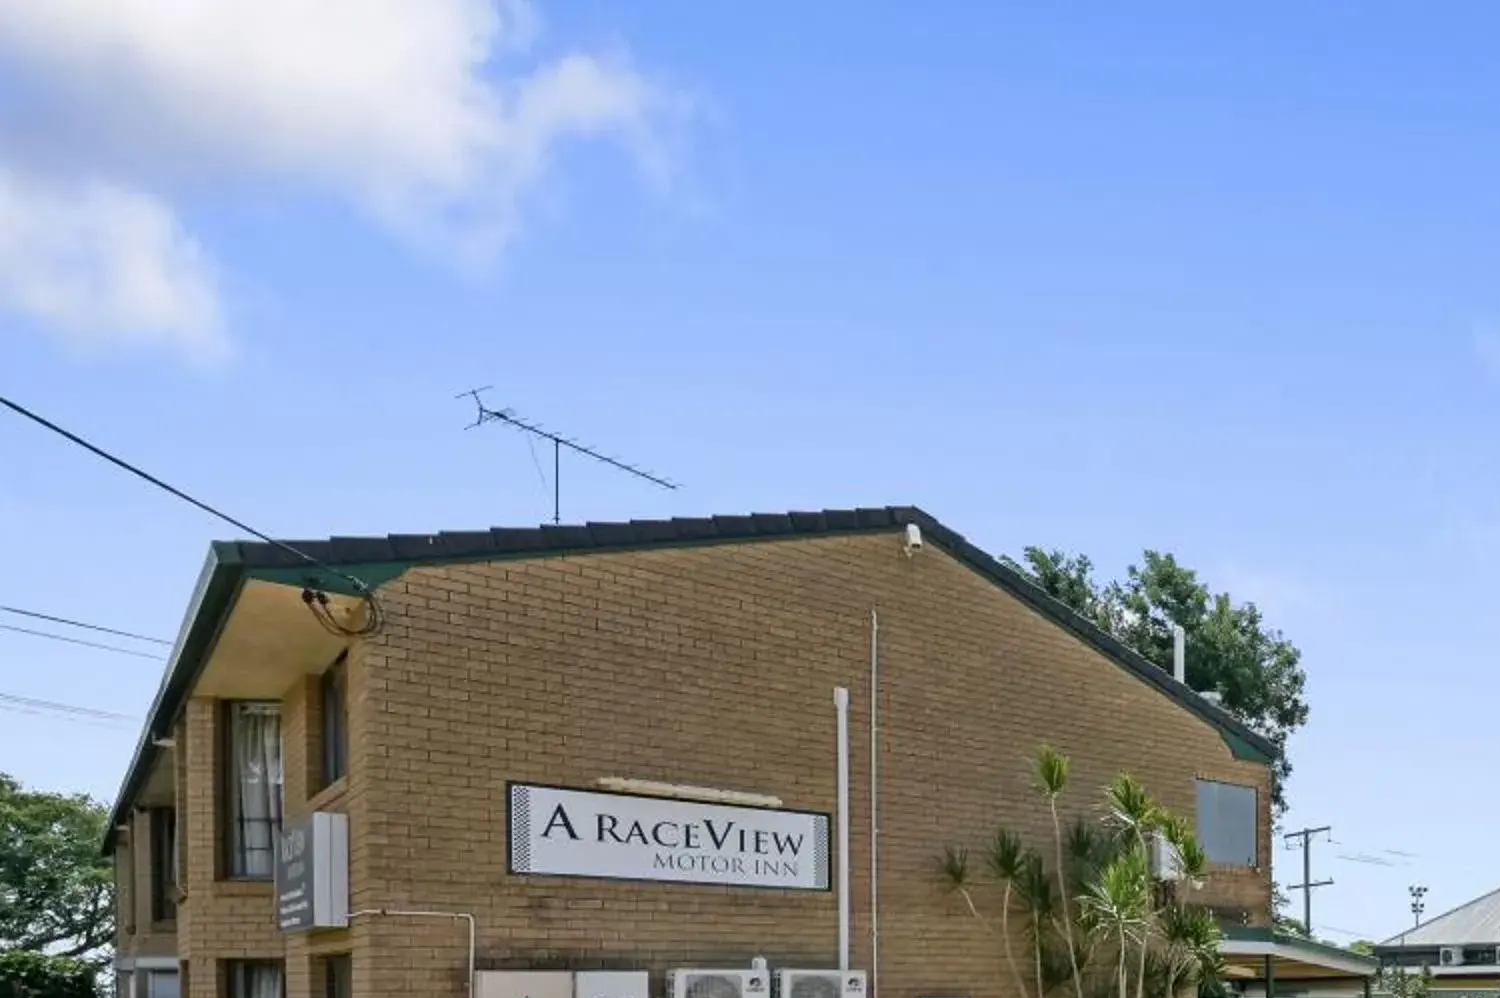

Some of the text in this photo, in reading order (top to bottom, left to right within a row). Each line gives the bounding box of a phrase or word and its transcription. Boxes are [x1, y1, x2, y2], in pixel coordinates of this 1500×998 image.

[541, 802, 581, 840] A
[653, 853, 799, 877] MOTOR INN
